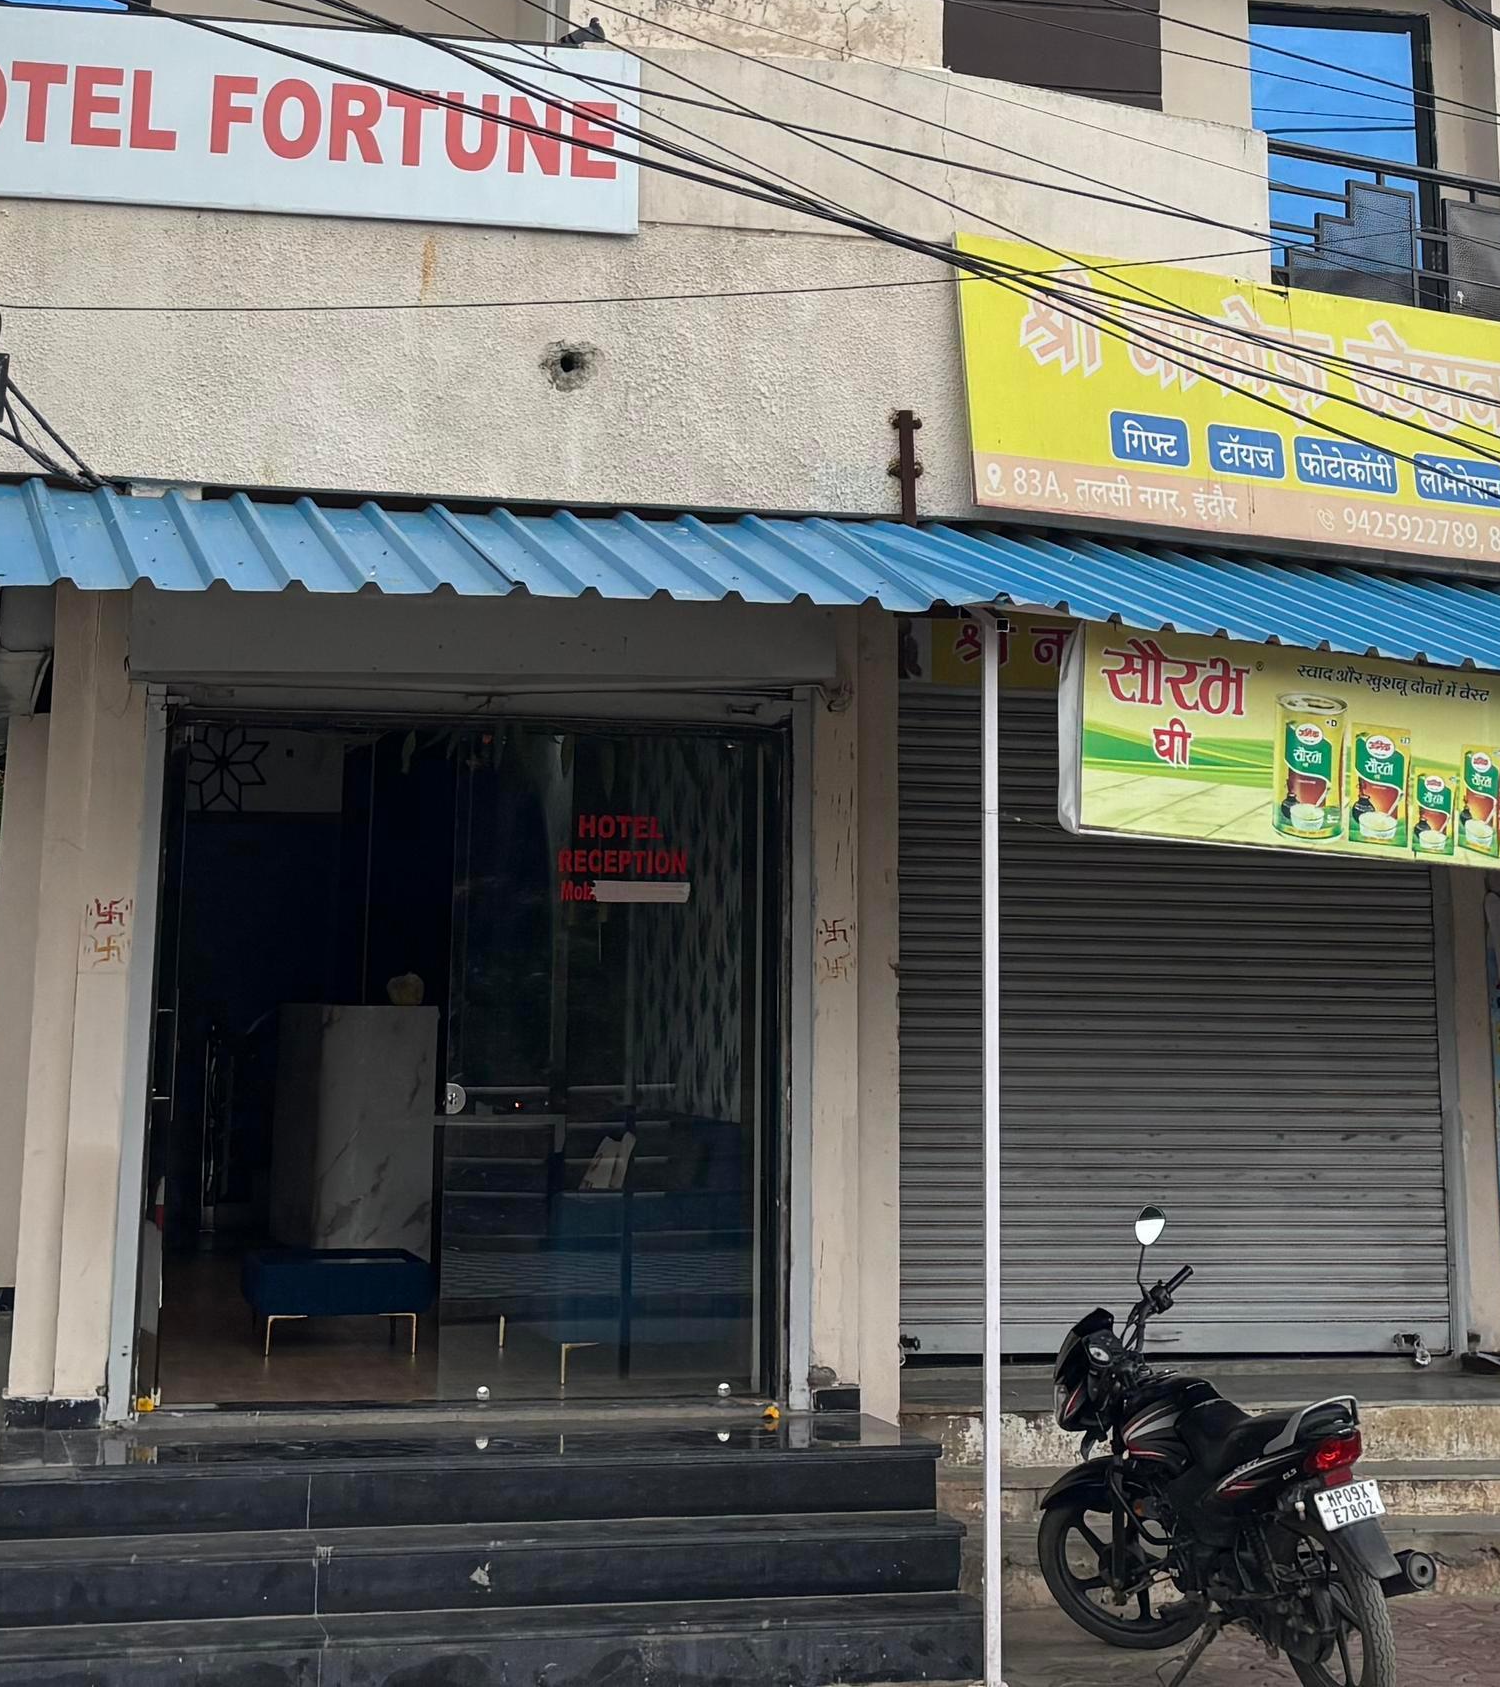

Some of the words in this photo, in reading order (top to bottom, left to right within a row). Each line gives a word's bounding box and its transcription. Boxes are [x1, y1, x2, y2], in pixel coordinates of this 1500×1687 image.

[210, 74, 619, 180] FORTUNE
[1020, 262, 1102, 378] श्री
[1123, 419, 1177, 458] गिफ्ट
[1217, 434, 1275, 472] टॉयज
[1299, 443, 1393, 488] फोटोकॉपी
[1013, 466, 1069, 504] 83A,
[1138, 485, 1187, 518] नगर,
[1192, 486, 1238, 522] इंदौर
[1343, 507, 1485, 553] 9425922789,
[1101, 638, 1250, 716] सौरभ
[1297, 664, 1334, 681] स्वाद
[1335, 665, 1363, 685] और
[1366, 674, 1409, 696] खुशबू
[1410, 675, 1443, 698] दोनों
[1445, 680, 1456, 698] में
[1459, 683, 1490, 702] बेस्ट
[1153, 717, 1193, 769] घी
[578, 814, 664, 839] HOTEL
[557, 848, 688, 875] RECEPTION
[1327, 1483, 1370, 1509] MP09X
[1333, 1500, 1376, 1525] E7802
